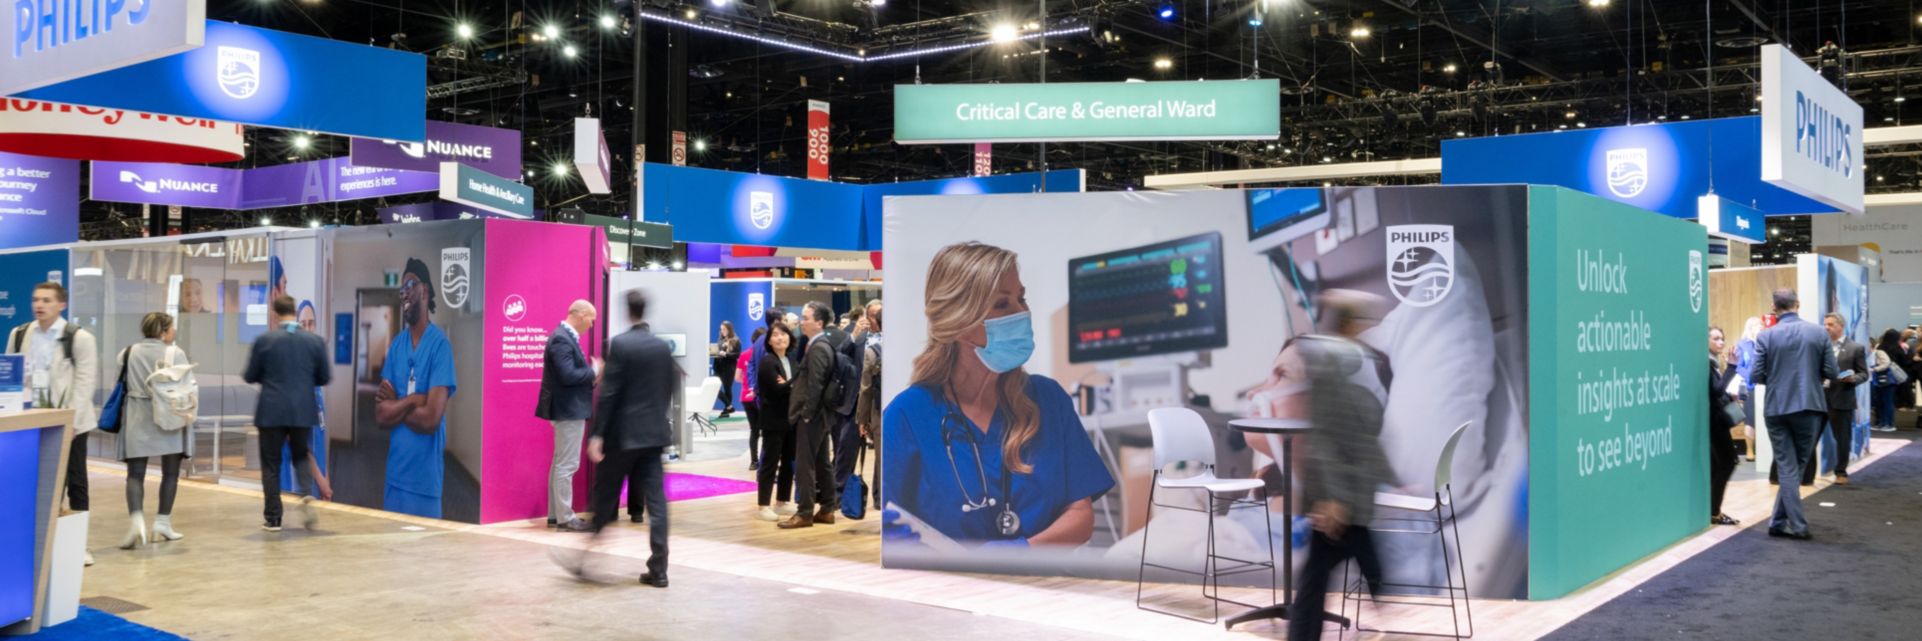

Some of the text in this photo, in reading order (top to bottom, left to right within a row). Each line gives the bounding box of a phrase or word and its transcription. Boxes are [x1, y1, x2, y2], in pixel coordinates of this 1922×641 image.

[956, 100, 1216, 120] Critical Care & General Ward
[809, 128, 819, 159] 900
[1796, 90, 1852, 179] PHILIPS
[427, 139, 492, 159] NUANCE
[819, 126, 829, 165] 1000
[17, 167, 51, 178] better
[160, 178, 218, 193] NUANCE
[341, 176, 397, 192] experiences is here.
[610, 225, 646, 237] Discover Zone
[1391, 231, 1450, 243] PHILIPS
[1843, 222, 1909, 232] HealthCare
[443, 253, 469, 261] PHILIPS
[1577, 248, 1628, 294] Unlock
[1577, 310, 1651, 353] actionable
[1577, 363, 1680, 422] insights at scale
[1577, 415, 1672, 476] to see beyond
